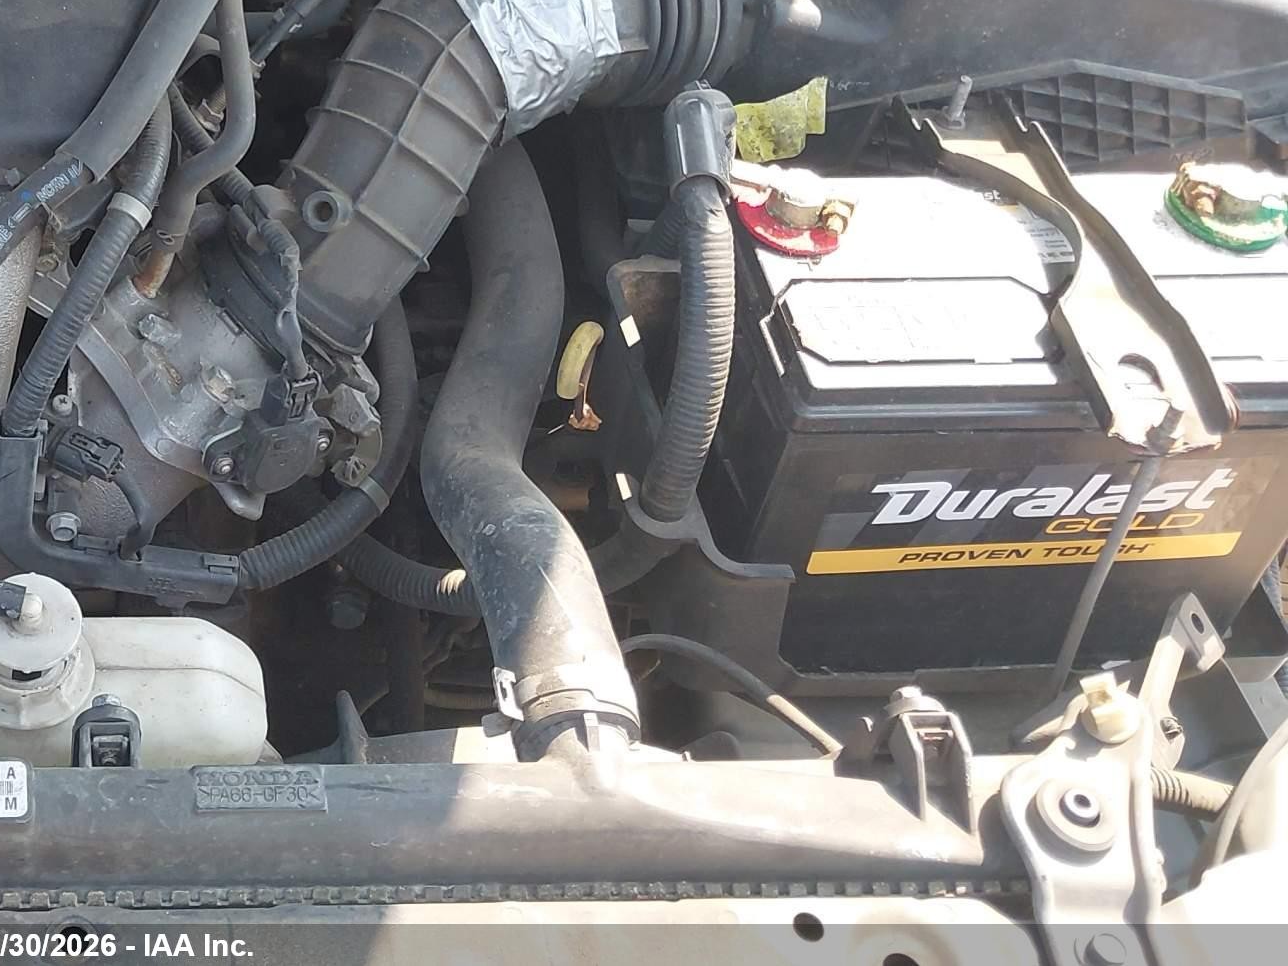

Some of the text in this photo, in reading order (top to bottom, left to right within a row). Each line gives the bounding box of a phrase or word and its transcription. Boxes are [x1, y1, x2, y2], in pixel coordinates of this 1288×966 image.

[871, 468, 1237, 525] Duralast
[1045, 512, 1205, 534] GOLD
[898, 547, 1032, 565] PROVEN
[6, 766, 17, 780] A
[196, 770, 320, 787] HONDA
[4, 797, 18, 811] M
